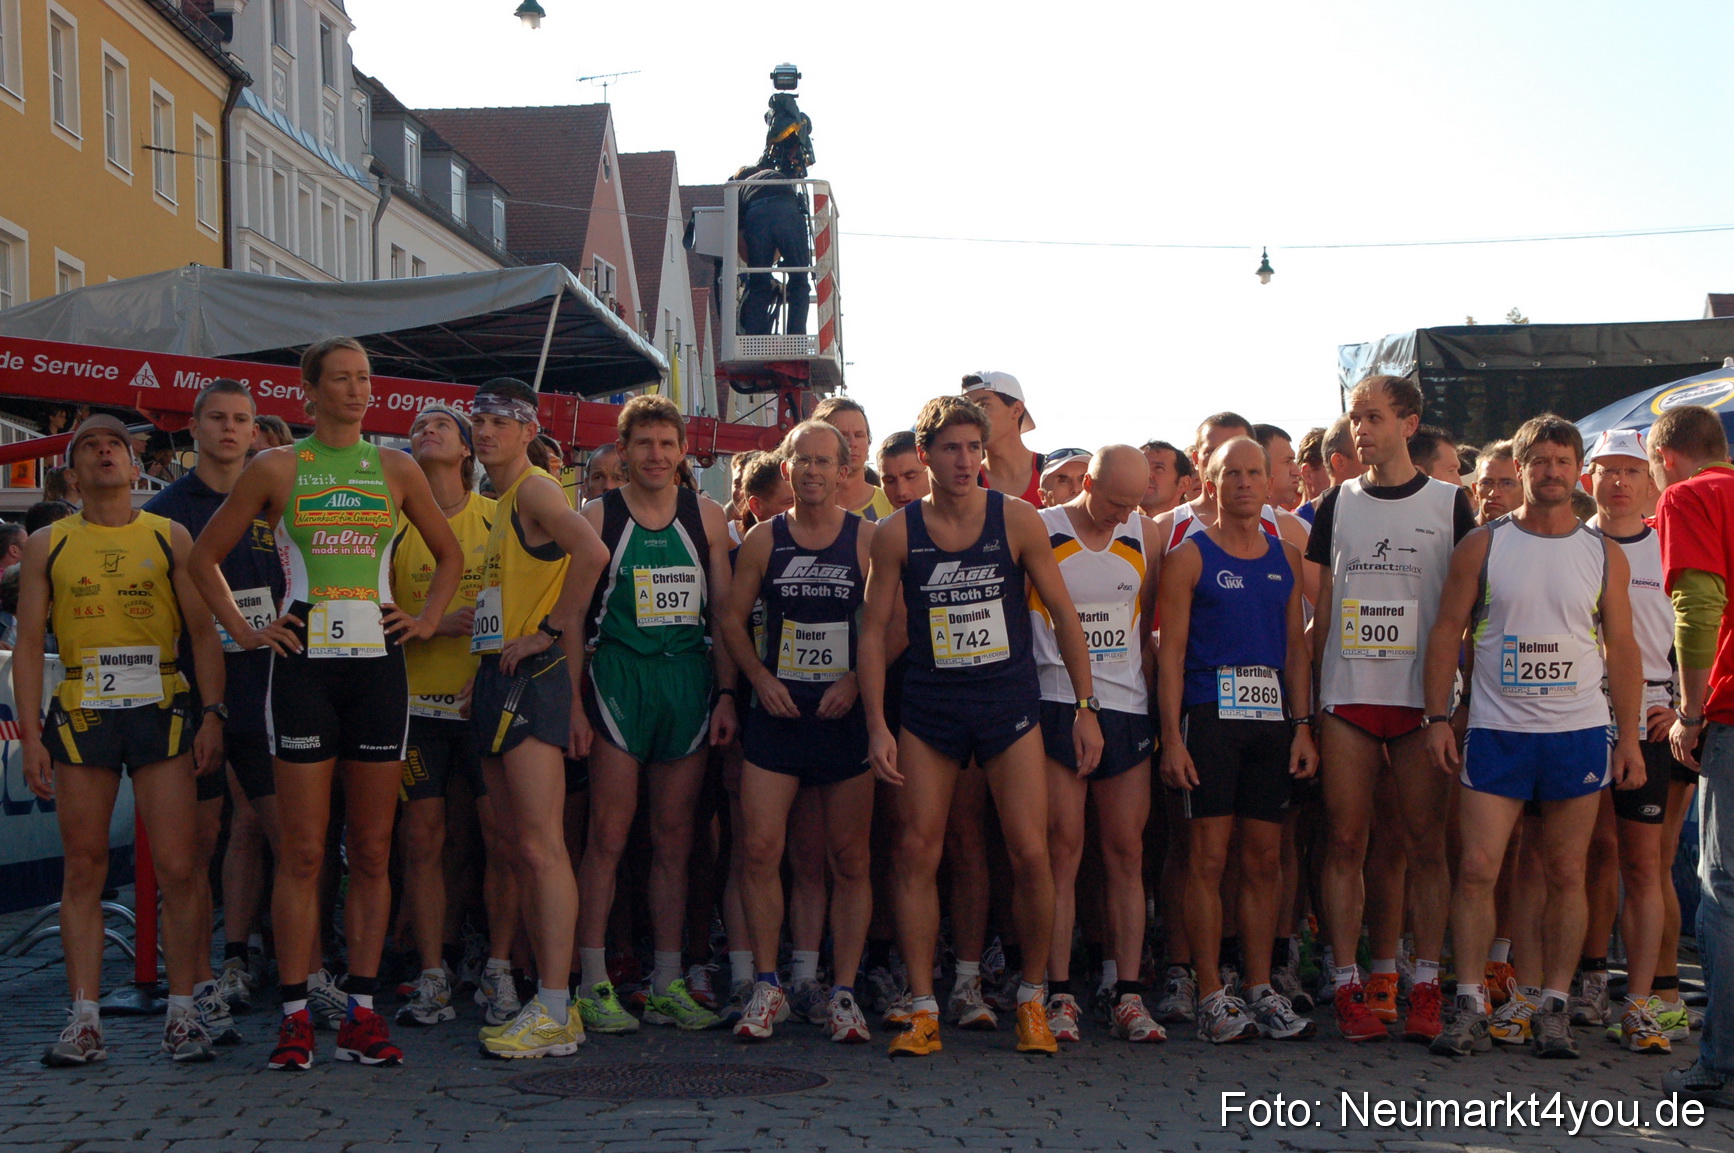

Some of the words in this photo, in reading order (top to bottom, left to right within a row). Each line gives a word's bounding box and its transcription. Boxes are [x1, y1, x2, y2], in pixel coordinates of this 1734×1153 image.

[32, 354, 119, 380] Service
[258, 380, 306, 401] Serv
[325, 493, 362, 507] Allos
[312, 530, 379, 545] Nalini
[312, 546, 339, 555] made
[341, 546, 351, 555] in
[353, 545, 376, 559] italy
[652, 572, 695, 584] Christian
[793, 566, 850, 580] NAGEL
[940, 567, 996, 584] NAGEL
[640, 590, 648, 600] A
[781, 585, 798, 597] SC
[802, 584, 831, 597] Roth
[834, 586, 850, 599] 52
[929, 591, 947, 603] SC
[950, 588, 982, 602] Roth
[985, 585, 1000, 598] 52
[656, 591, 690, 609] 897
[97, 604, 105, 614] S
[1360, 605, 1404, 617] Manfred
[948, 608, 991, 625] Dominik
[1078, 611, 1109, 623] Martin
[331, 620, 345, 639] 5
[1345, 621, 1354, 631] A
[1361, 624, 1399, 642] 900
[796, 629, 827, 641] Dieter
[936, 630, 945, 640] A
[953, 629, 990, 650] 742
[782, 642, 790, 652] A
[1519, 642, 1559, 653] Helmut
[100, 654, 153, 667] Wolfgang
[797, 648, 833, 666] 726
[1504, 658, 1513, 668] A
[86, 672, 94, 682] A
[1521, 661, 1573, 679] 2657
[103, 674, 115, 692] 2
[1222, 682, 1230, 691] C
[1238, 685, 1278, 705] 2869
